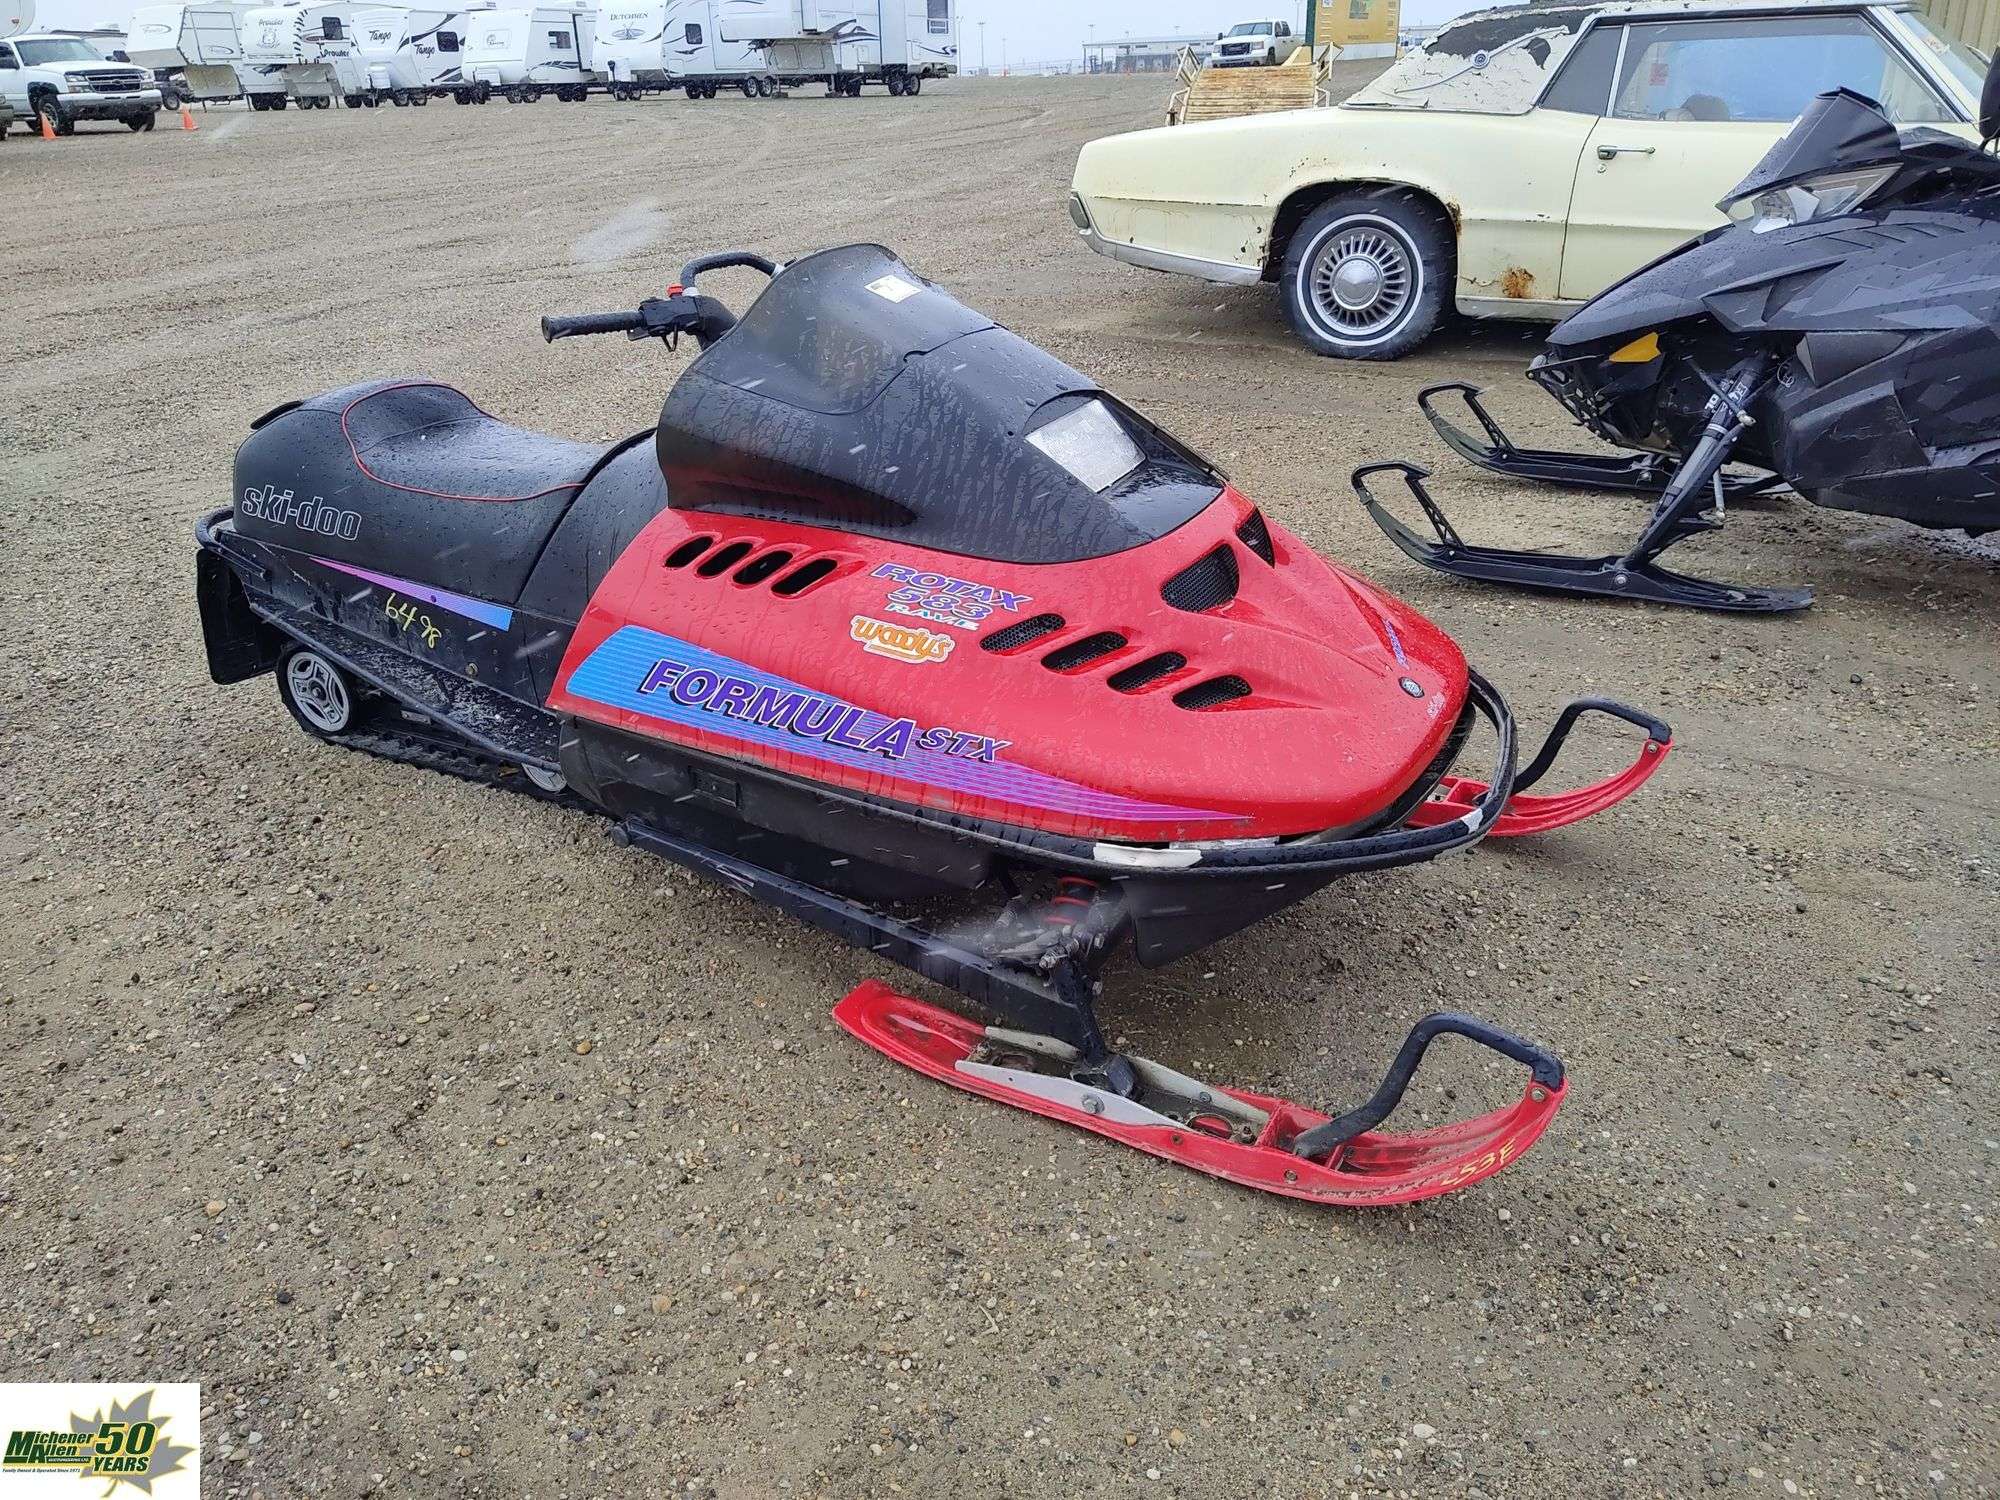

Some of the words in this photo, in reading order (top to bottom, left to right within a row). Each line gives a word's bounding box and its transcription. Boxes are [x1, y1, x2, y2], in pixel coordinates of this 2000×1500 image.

[368, 29, 392, 45] Tango
[413, 43, 436, 58] Tango
[241, 484, 362, 541] ski-doo
[871, 562, 1033, 612] ROTAX
[887, 586, 993, 620] 583
[385, 592, 442, 649] 6498
[637, 658, 917, 760] FORMULA
[918, 727, 1013, 762] STX
